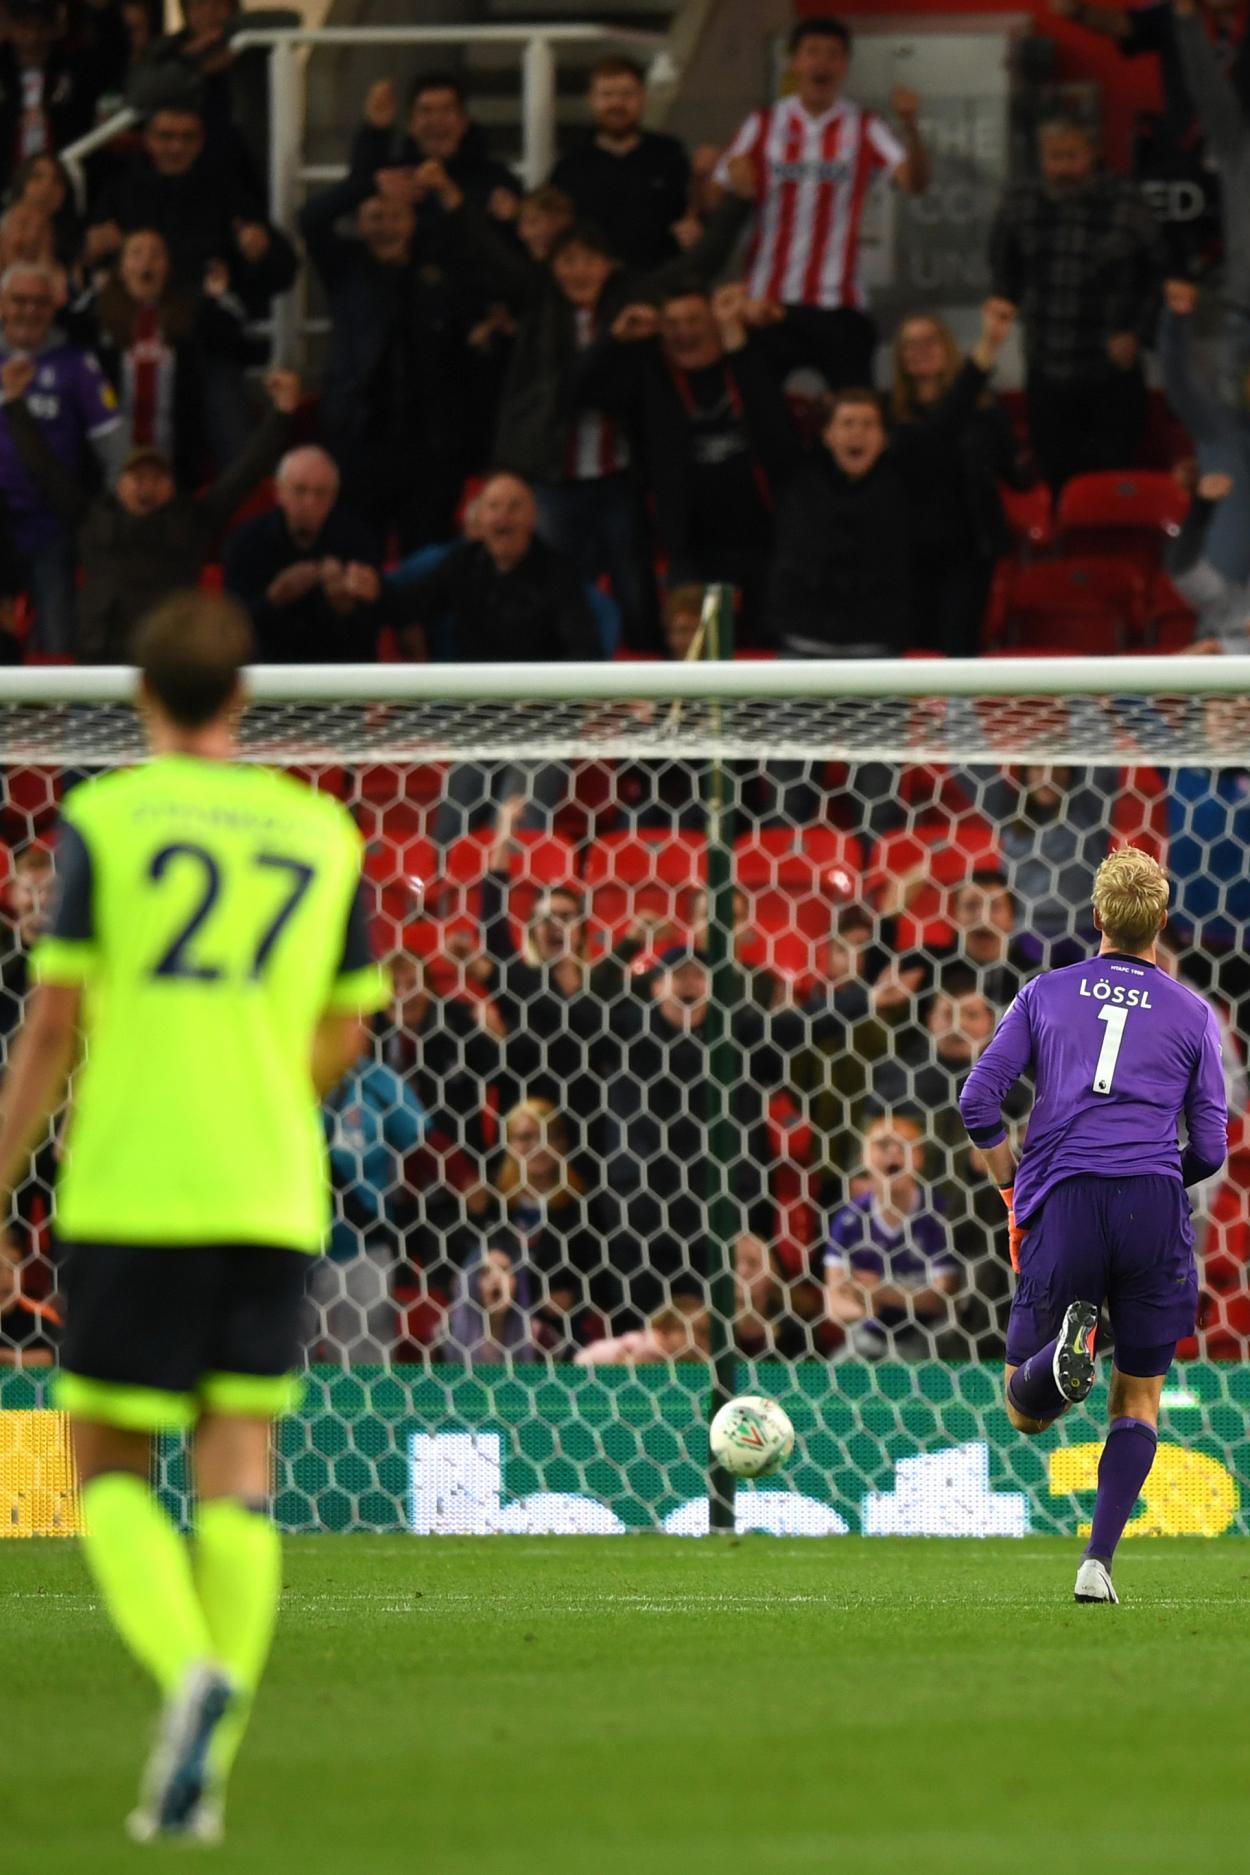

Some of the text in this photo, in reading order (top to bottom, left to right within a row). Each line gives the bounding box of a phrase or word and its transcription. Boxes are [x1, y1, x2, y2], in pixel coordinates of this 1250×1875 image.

[150, 842, 315, 980] 27
[1079, 978, 1152, 1009] LÖSSL
[1093, 1004, 1129, 1095] 1
